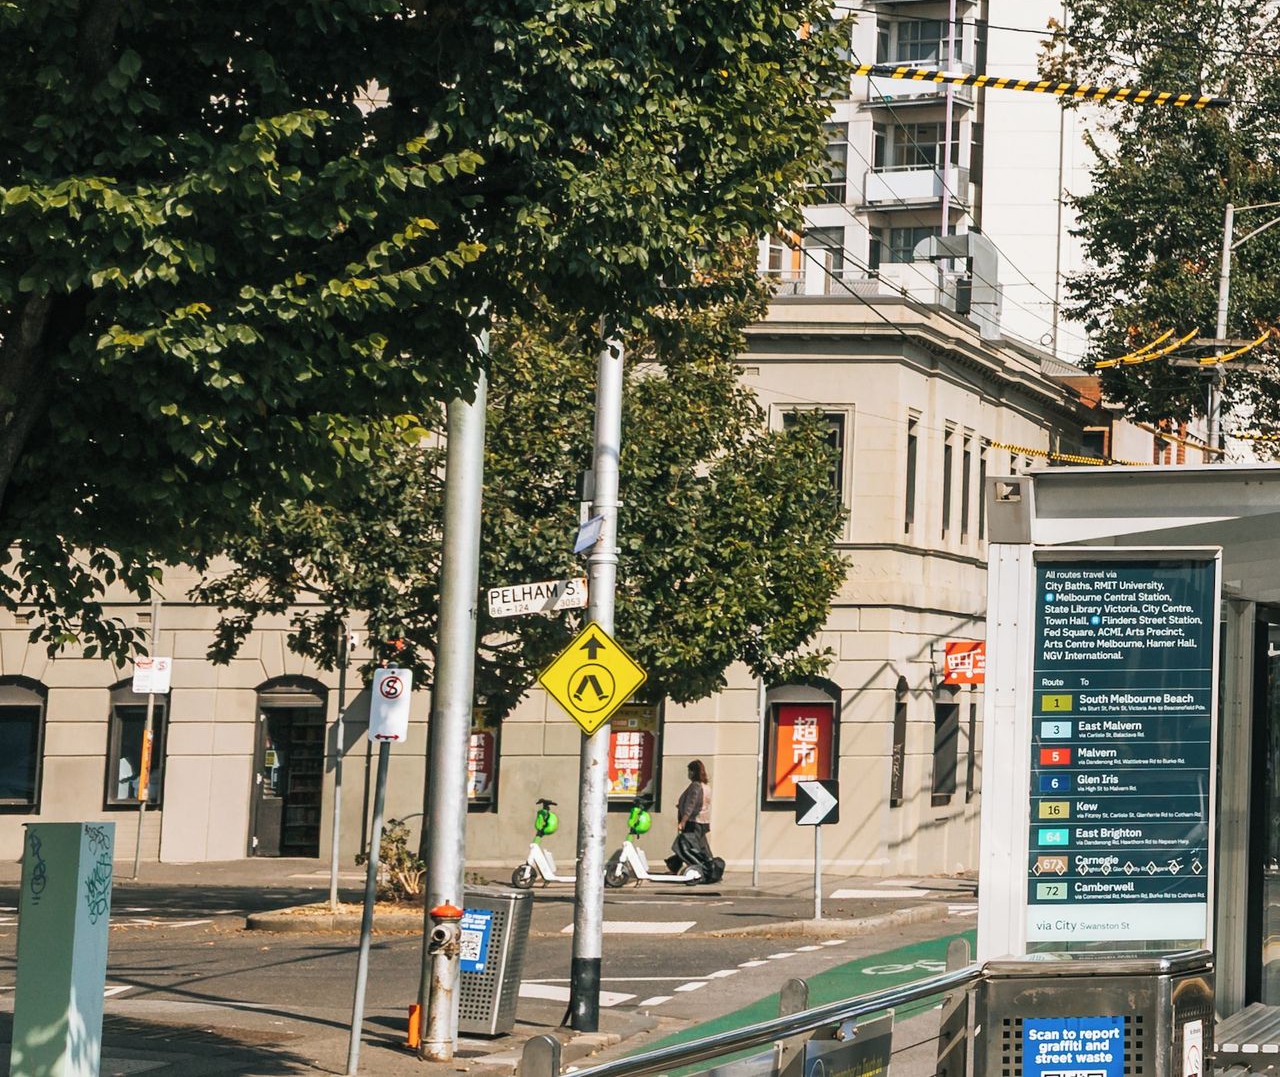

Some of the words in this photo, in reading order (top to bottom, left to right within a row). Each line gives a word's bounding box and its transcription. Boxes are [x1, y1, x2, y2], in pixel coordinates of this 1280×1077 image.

[1106, 570, 1117, 578] via
[1045, 582, 1063, 592] City
[1065, 581, 1092, 590] Baths,
[1094, 581, 1118, 589] RMIT
[1119, 581, 1164, 591] University,
[490, 584, 558, 605] PELHAM
[1056, 593, 1102, 602] Melbourne
[1104, 593, 1136, 601] Central
[1138, 592, 1172, 602] Station,
[490, 607, 502, 615] 86
[514, 604, 529, 612] 124
[560, 598, 581, 607] 3053
[1045, 605, 1069, 613] State
[1071, 605, 1102, 615] Library
[1104, 604, 1140, 613] Victoria,
[1142, 604, 1160, 615] City
[1162, 604, 1194, 613] Centre,
[1044, 616, 1068, 625] Town
[1069, 616, 1089, 625] Hall,
[1102, 616, 1137, 624] Flinders
[1139, 616, 1166, 624] Street
[1169, 615, 1202, 624] Station,
[1044, 628, 1061, 636] Fed
[1062, 628, 1096, 638] Square,
[1097, 627, 1123, 637] ACMI,
[1125, 627, 1145, 636] Arts
[1146, 627, 1185, 636] Precinct,
[1044, 640, 1063, 648] Arts
[1065, 639, 1095, 648] Centre
[1097, 639, 1145, 648] Melbourne,
[1147, 639, 1176, 647] Hamer
[1177, 639, 1197, 648] Hall,
[1043, 651, 1063, 660] NGV
[1065, 651, 1123, 660] International.
[1042, 678, 1064, 686] Route
[1080, 678, 1089, 686] To
[1054, 699, 1060, 708] 1
[1080, 694, 1108, 704] South
[1110, 694, 1162, 703] Melbourne
[1164, 694, 1194, 703] Beach
[1054, 725, 1060, 734] 3
[1079, 721, 1101, 730] East
[1103, 721, 1142, 730] Malvern
[792, 716, 818, 767] 超市
[1052, 752, 1059, 761] 5
[1078, 748, 1117, 757] Malvern
[1051, 778, 1058, 788] 6
[1077, 775, 1100, 784] Glen
[1102, 774, 1118, 784] Iris
[1048, 806, 1060, 815] 16
[1077, 802, 1098, 811] Kew
[1046, 831, 1061, 843] 64
[1076, 828, 1099, 838] East
[1101, 828, 1142, 839] Brighton
[1075, 856, 1119, 865] Carnegie
[1046, 886, 1058, 896] 72
[1075, 882, 1134, 892] Camberwell
[1036, 921, 1052, 930] via
[1055, 920, 1077, 932] City
[1080, 922, 1119, 930] Swanston
[1029, 1029, 1059, 1040] Scan
[1062, 1029, 1076, 1041] to
[1079, 1028, 1120, 1041] report
[1039, 1039, 1082, 1054] graffiti
[1085, 1039, 1110, 1052] and
[1035, 1050, 1072, 1064] street
[1075, 1050, 1113, 1063] waste
